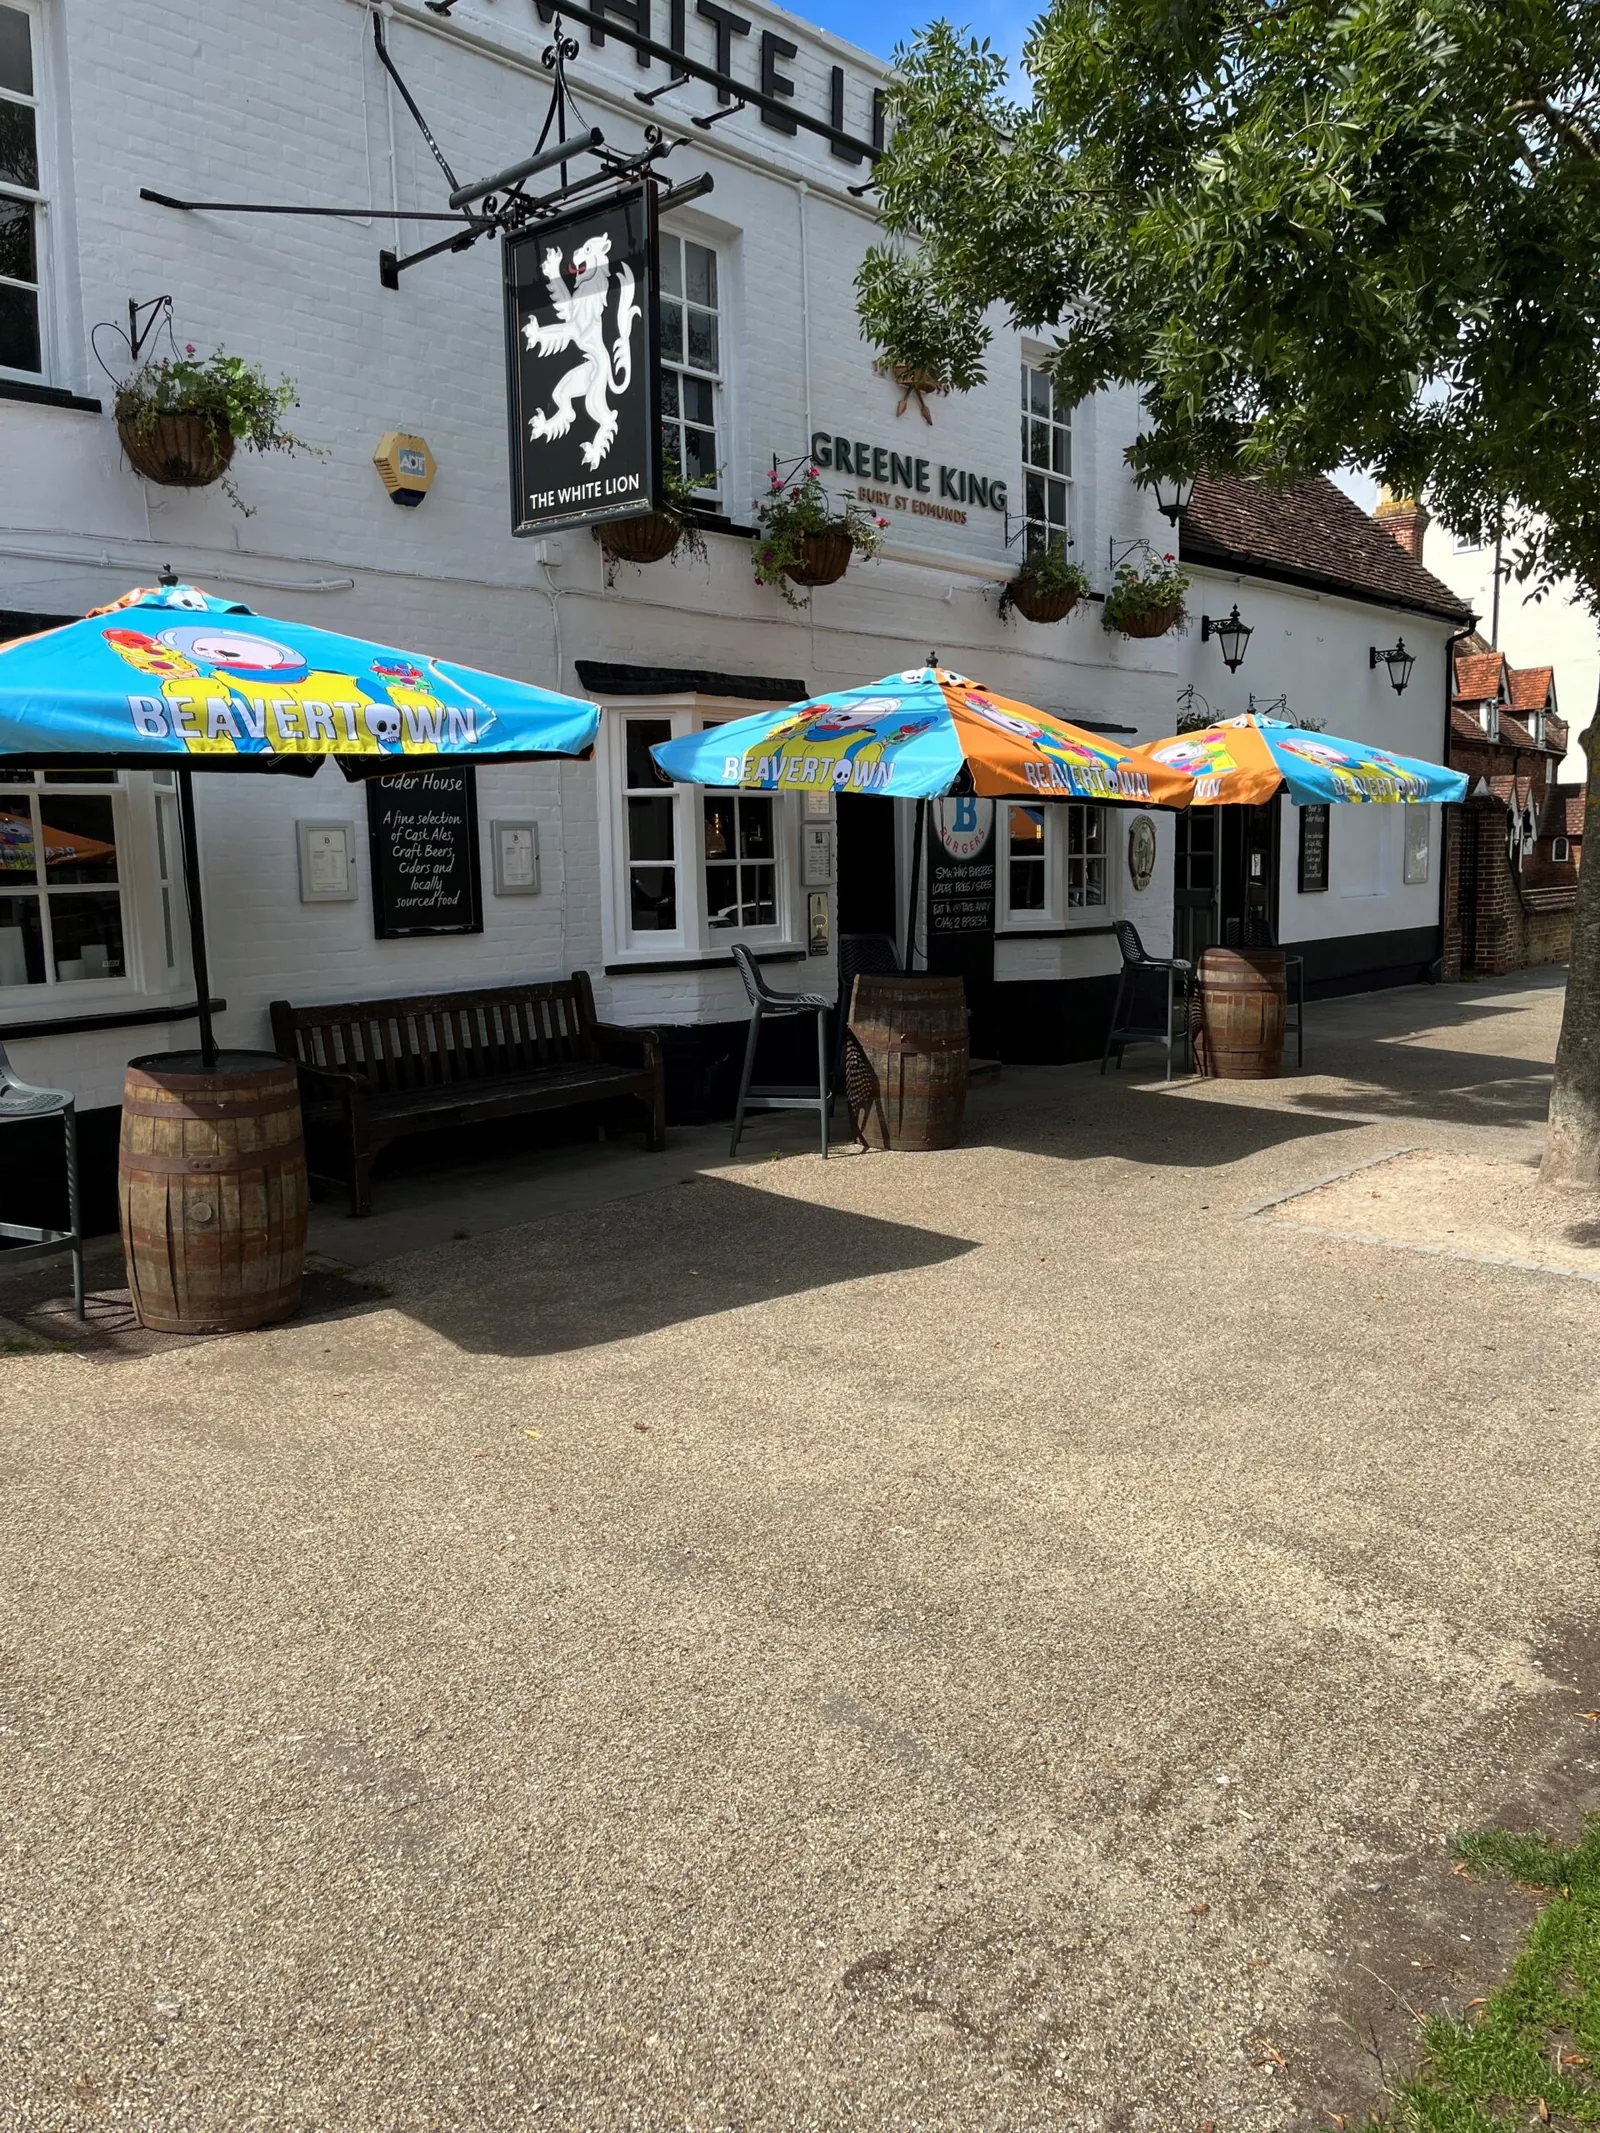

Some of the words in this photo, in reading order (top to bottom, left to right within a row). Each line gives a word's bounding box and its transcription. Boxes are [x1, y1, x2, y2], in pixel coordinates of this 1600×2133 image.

[536, 0, 799, 136] HITE
[400, 454, 425, 471] ADT
[811, 431, 931, 493] GREENE
[940, 465, 1007, 511] KING
[529, 490, 555, 510] THE
[557, 482, 602, 504] WHITE
[605, 473, 640, 496] LION
[858, 486, 892, 506] BURY
[894, 495, 909, 510] ST
[912, 499, 968, 525] EDMUNDS
[126, 695, 480, 744] BEAVERTOWN
[422, 772, 463, 791] House
[721, 756, 896, 788] BEAVERTOWN
[1024, 761, 1151, 797] BEAVERTOWN
[1331, 777, 1429, 797] BEAVERTOWN
[383, 810, 392, 825] A
[393, 809, 415, 828] fine
[416, 810, 463, 825] selection
[952, 797, 977, 832] B
[391, 827, 404, 842] of
[405, 828, 430, 841] Cask
[431, 827, 454, 843] Ales,
[941, 827, 985, 855] BURGERS
[392, 843, 422, 859] Craft
[424, 845, 455, 859] Beers,
[399, 859, 430, 874] Ciders
[433, 859, 453, 874] and
[410, 876, 443, 895] locally
[395, 892, 436, 908] sourced
[436, 890, 461, 908] food
